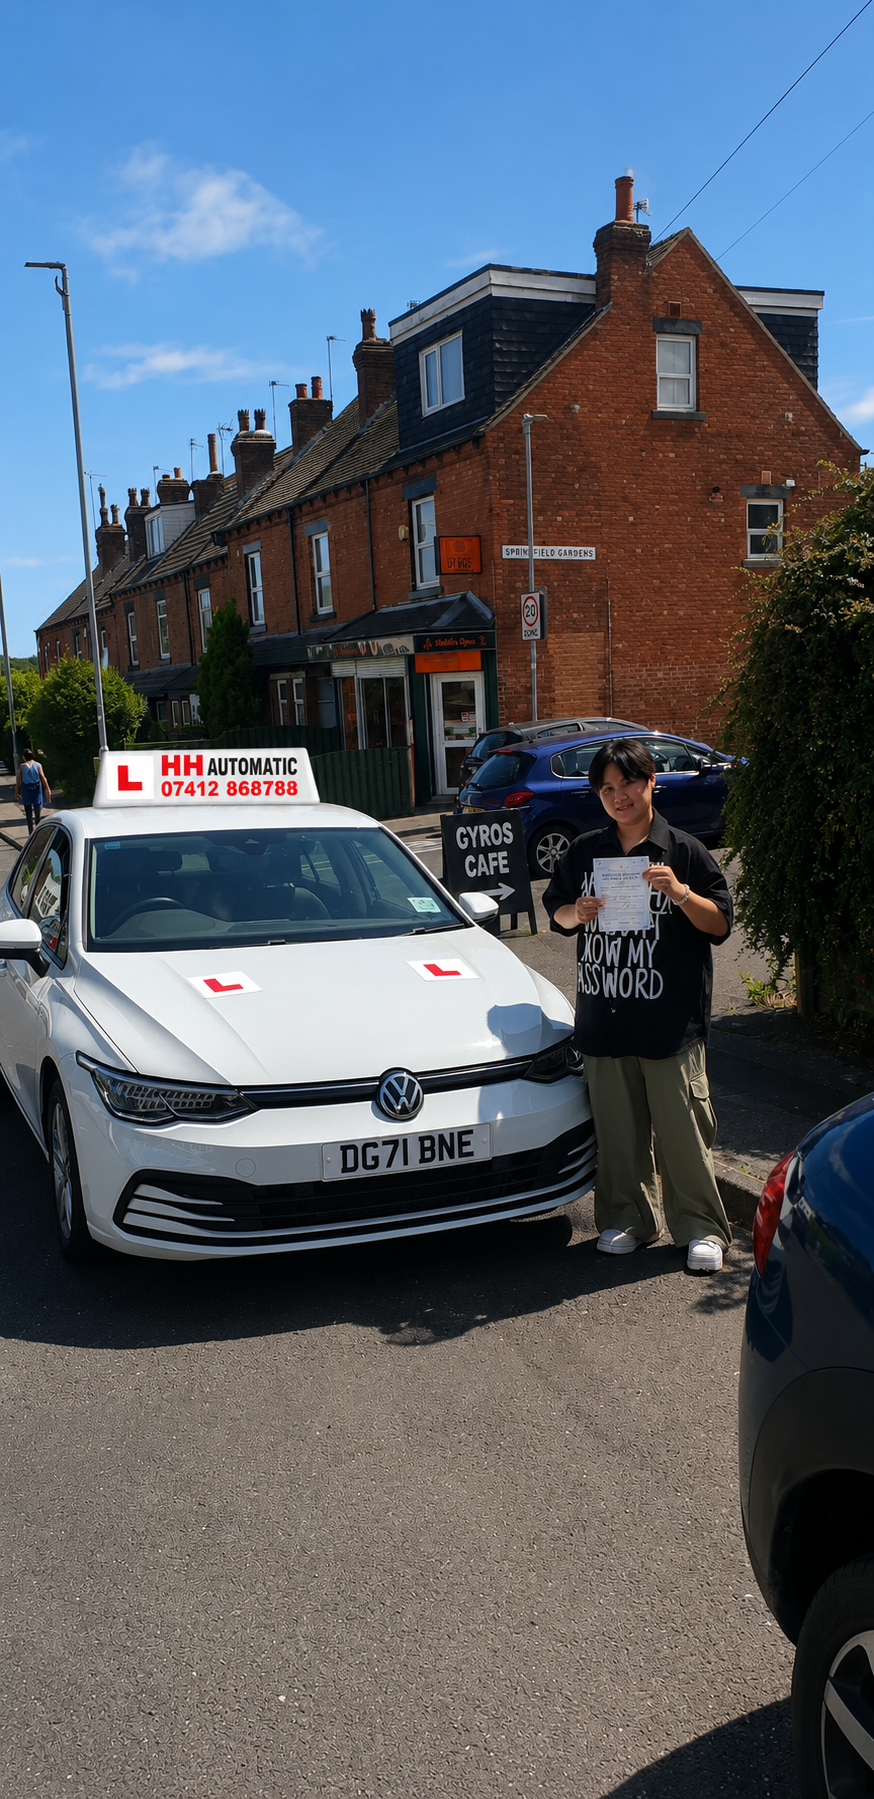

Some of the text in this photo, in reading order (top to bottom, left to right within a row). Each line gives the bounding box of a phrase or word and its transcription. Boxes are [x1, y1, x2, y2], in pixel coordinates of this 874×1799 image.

[505, 547, 594, 558] SPRINFIELD GARDENS
[525, 604, 536, 618] 20
[161, 754, 298, 777] HH AUTOMATIC
[117, 765, 143, 791] L
[161, 780, 298, 797] 07412 868788
[455, 822, 514, 850] GYROS
[464, 850, 510, 878] CAFE
[627, 938, 658, 969] MY
[422, 963, 462, 977] L
[202, 978, 244, 993] L
[340, 1129, 475, 1174] DG71 BNE
